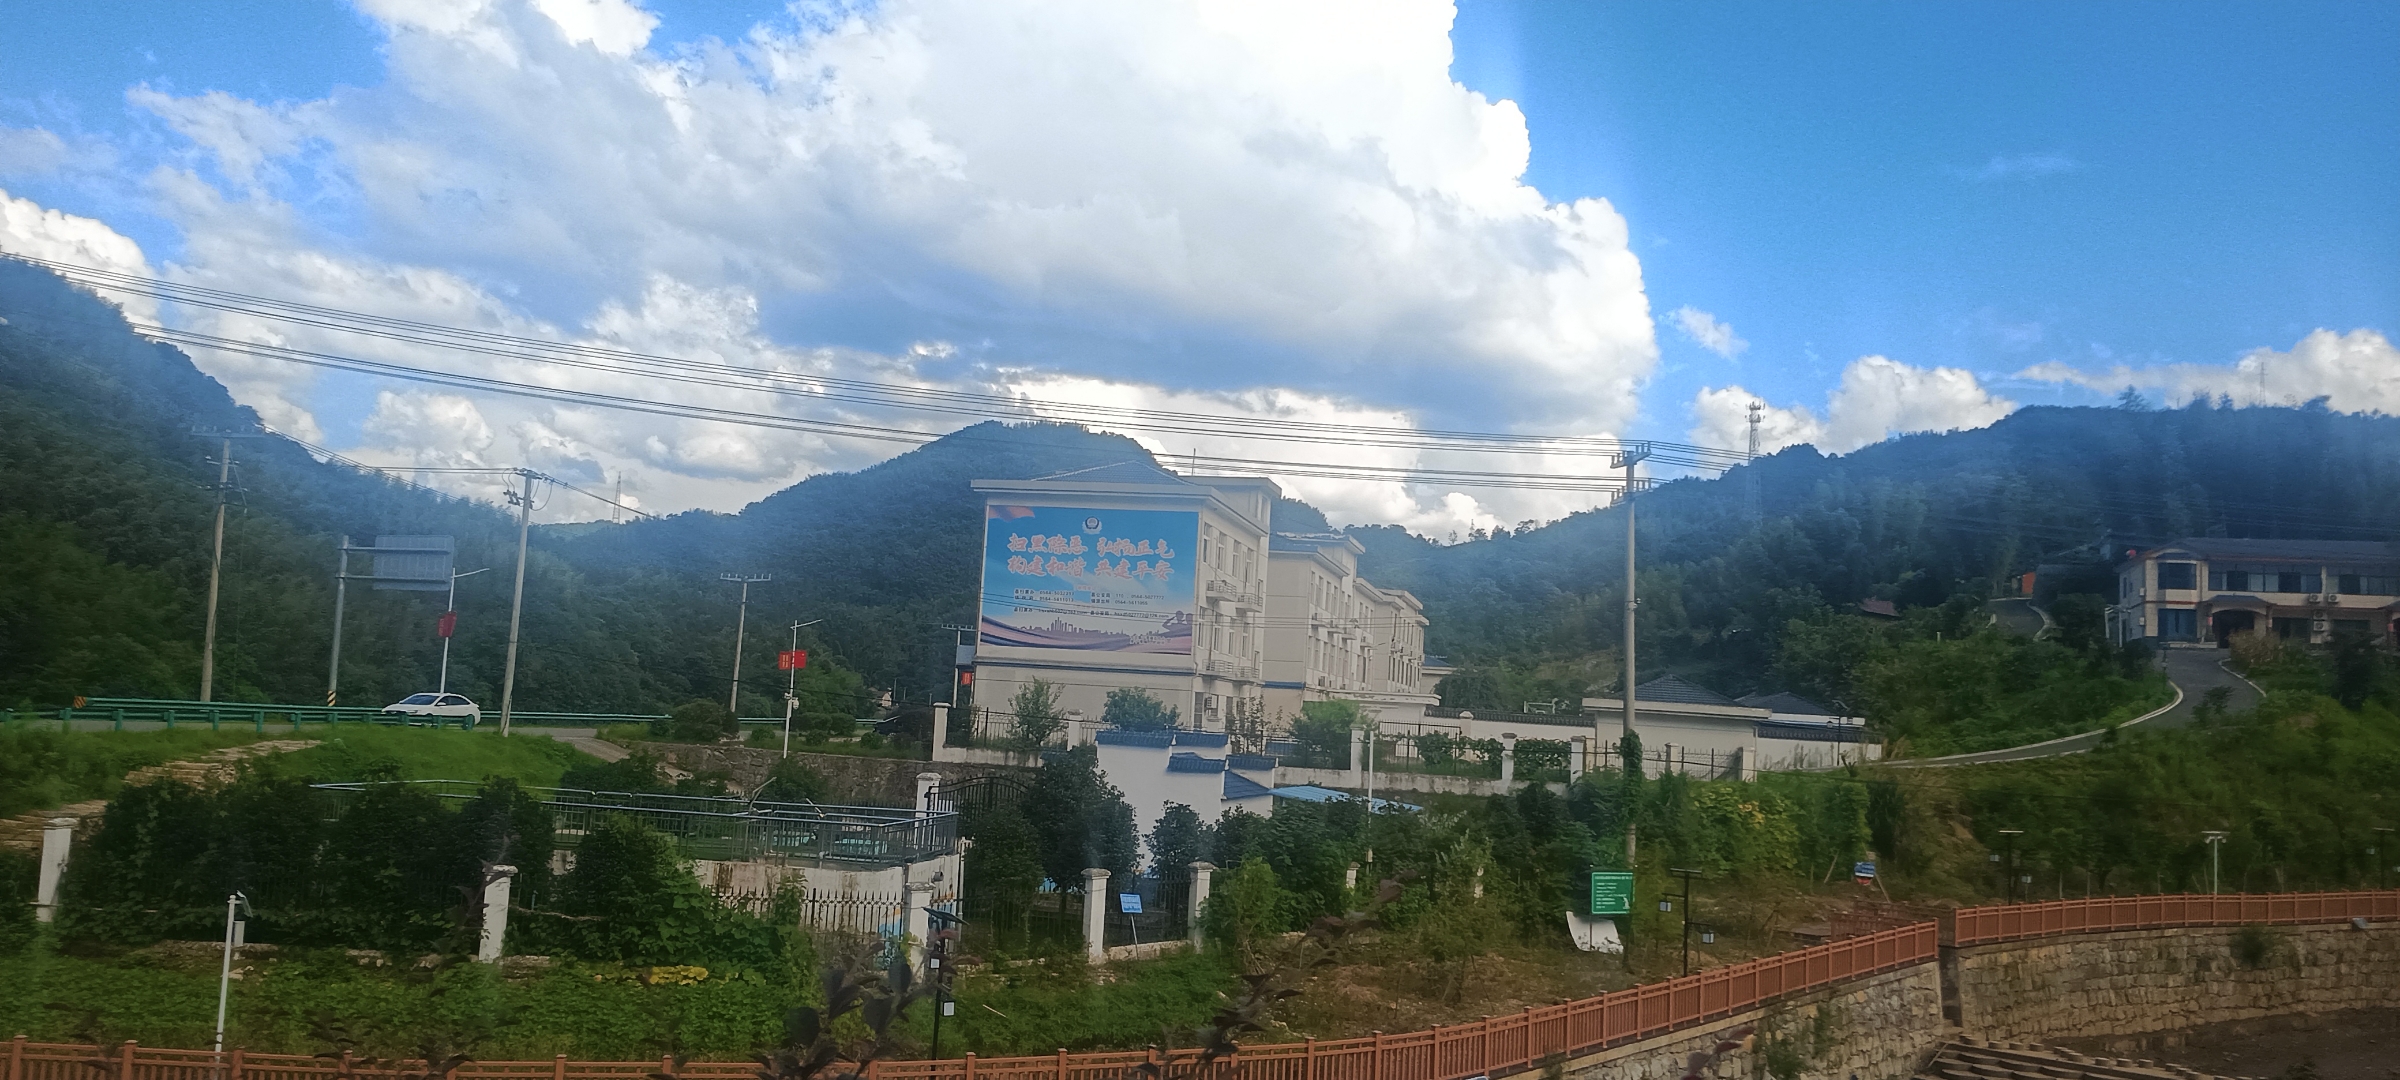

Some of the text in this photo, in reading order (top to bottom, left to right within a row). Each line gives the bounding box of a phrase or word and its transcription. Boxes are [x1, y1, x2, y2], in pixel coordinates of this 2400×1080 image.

[1007, 533, 1175, 558] 扫黑除恶 弘扬正气
[1007, 555, 1174, 581] 构建和谐 共建平安
